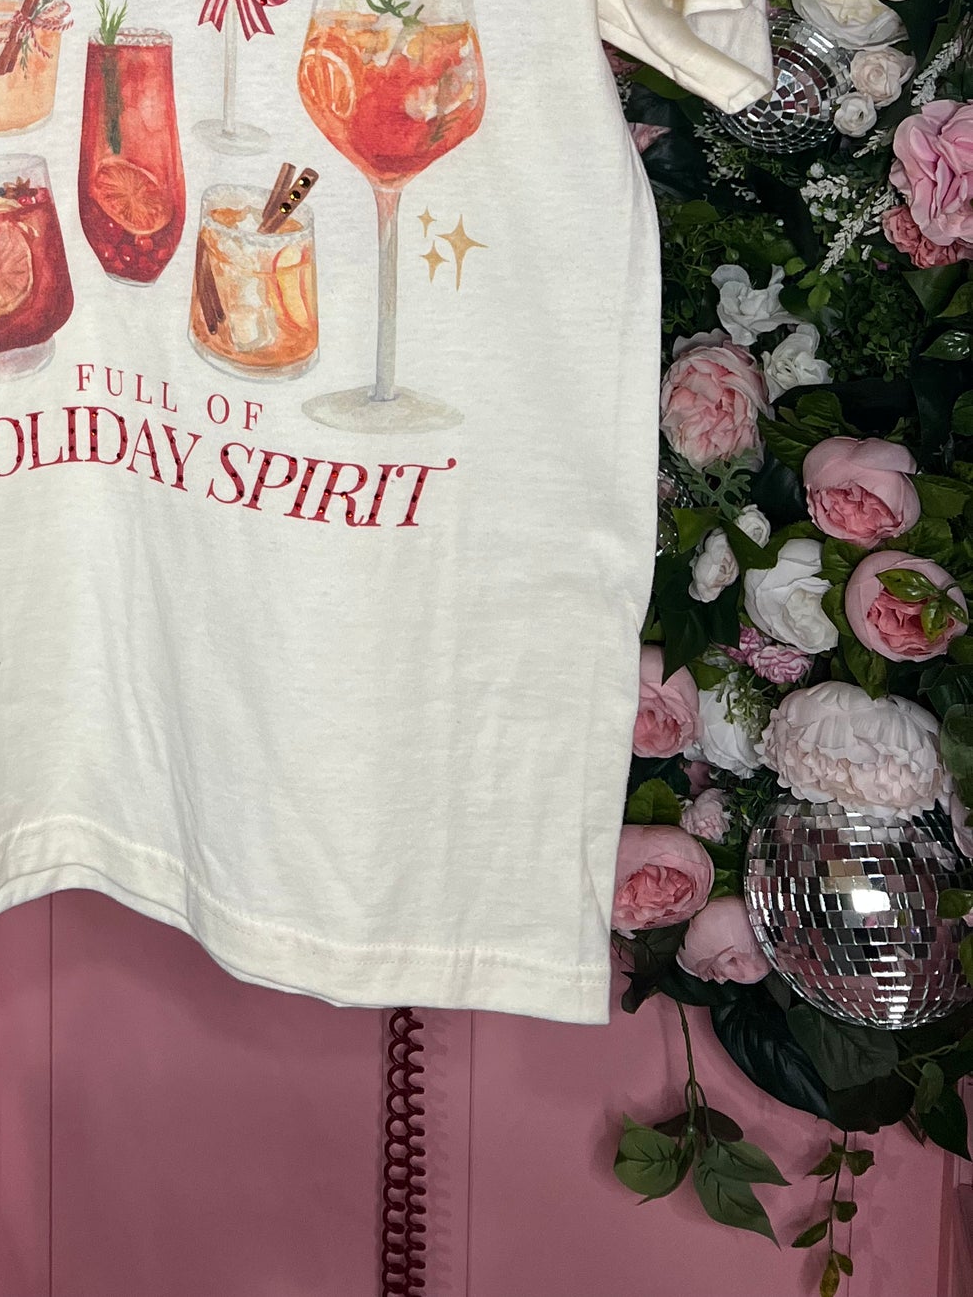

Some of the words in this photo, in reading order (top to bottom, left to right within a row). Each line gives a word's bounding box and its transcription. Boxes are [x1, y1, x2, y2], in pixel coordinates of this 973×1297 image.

[75, 363, 179, 413] FULL
[206, 393, 264, 432] OF
[205, 441, 458, 529] SPIRIT
